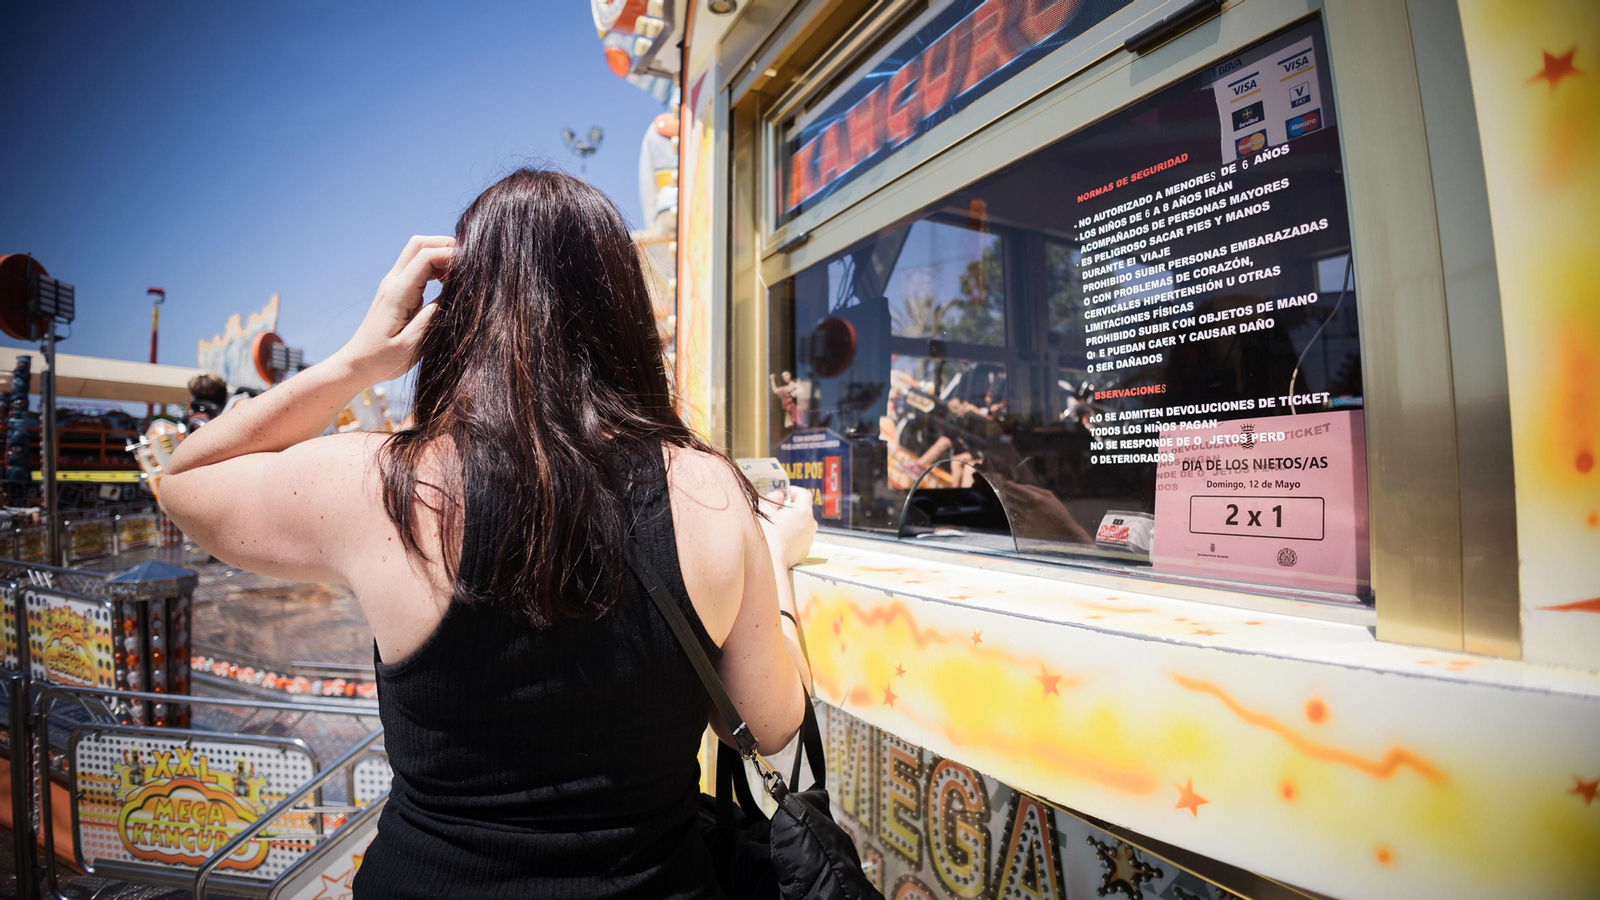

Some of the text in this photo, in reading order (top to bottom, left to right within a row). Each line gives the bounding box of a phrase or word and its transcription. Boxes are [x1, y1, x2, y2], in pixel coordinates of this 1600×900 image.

[1219, 59, 1242, 75] BBVA
[1283, 56, 1308, 72] VISA
[1233, 80, 1257, 95] VISA
[1291, 118, 1316, 131] Maestro
[1077, 153, 1188, 203] NORMAS DE SEGURIDAD
[1094, 194, 1153, 224] AUTORIZADO
[1155, 192, 1163, 201] A
[1165, 171, 1216, 196] MENORES
[1221, 164, 1236, 177] DE
[1242, 160, 1248, 170] 6
[1254, 144, 1290, 165] AÑOS
[1080, 178, 1290, 254] ACOMPAÑADOS DE PERSONAS MAYORES
[1099, 220, 1127, 235] NIÑOS
[1129, 213, 1142, 225] DE
[1145, 210, 1150, 218] 6
[1153, 206, 1161, 216] A
[1162, 203, 1169, 212] 8
[1172, 192, 1202, 210] AÑOS
[1204, 181, 1233, 198] IRÁN
[1094, 239, 1146, 262] PELIGROSO
[1149, 227, 1184, 244] SACAR
[1186, 219, 1212, 235] PIES
[1214, 216, 1222, 226] Y
[1226, 201, 1270, 222] MANOS
[1082, 261, 1124, 280] DURANTE
[1141, 247, 1170, 263] VIAJE
[1083, 218, 1328, 292] PROHIBIDO SUBIR PERSONAS EMBARAZADAS
[1084, 256, 1254, 306] O CON PROBLEMAS DE CORAZÓN,
[1084, 266, 1280, 319] CERVICALES HIPERTENSIÓN U OTRAS
[1085, 301, 1194, 333] LIMITACIONES FÍSICAS
[1086, 292, 1318, 346] PROHIBIDO SUBIR CON OBJETOS DE MANO
[1086, 318, 1275, 360] QE PUEDAN CAER Y CAUSAR DAÑO
[1087, 353, 1162, 373] O SER DAÑADOS
[1094, 384, 1167, 400] BSERVACIONES
[1105, 412, 1117, 421] SE
[1119, 408, 1163, 420] ADMITEN
[1166, 399, 1255, 416] DEVOLUCIONES
[1258, 397, 1276, 408] DE
[1279, 392, 1330, 406] TICKET
[1090, 419, 1217, 437] TODOS LOS NIÑOS PAGAN
[1090, 441, 1103, 450] NO
[1106, 440, 1118, 449] SE
[1120, 437, 1175, 449] RESPONDE
[1176, 437, 1190, 446] DE
[1091, 453, 1175, 464] O DETERIORADOS
[1182, 456, 1328, 471] DIA DE LOS NIETOS/AS
[831, 463, 838, 492] 5
[1206, 480, 1301, 491] Domingo, 12 de Mayo
[1225, 503, 1282, 528] 2 x 1
[151, 746, 218, 783] XXL
[153, 798, 227, 827] MEGA
[825, 707, 1062, 900] MEGA
